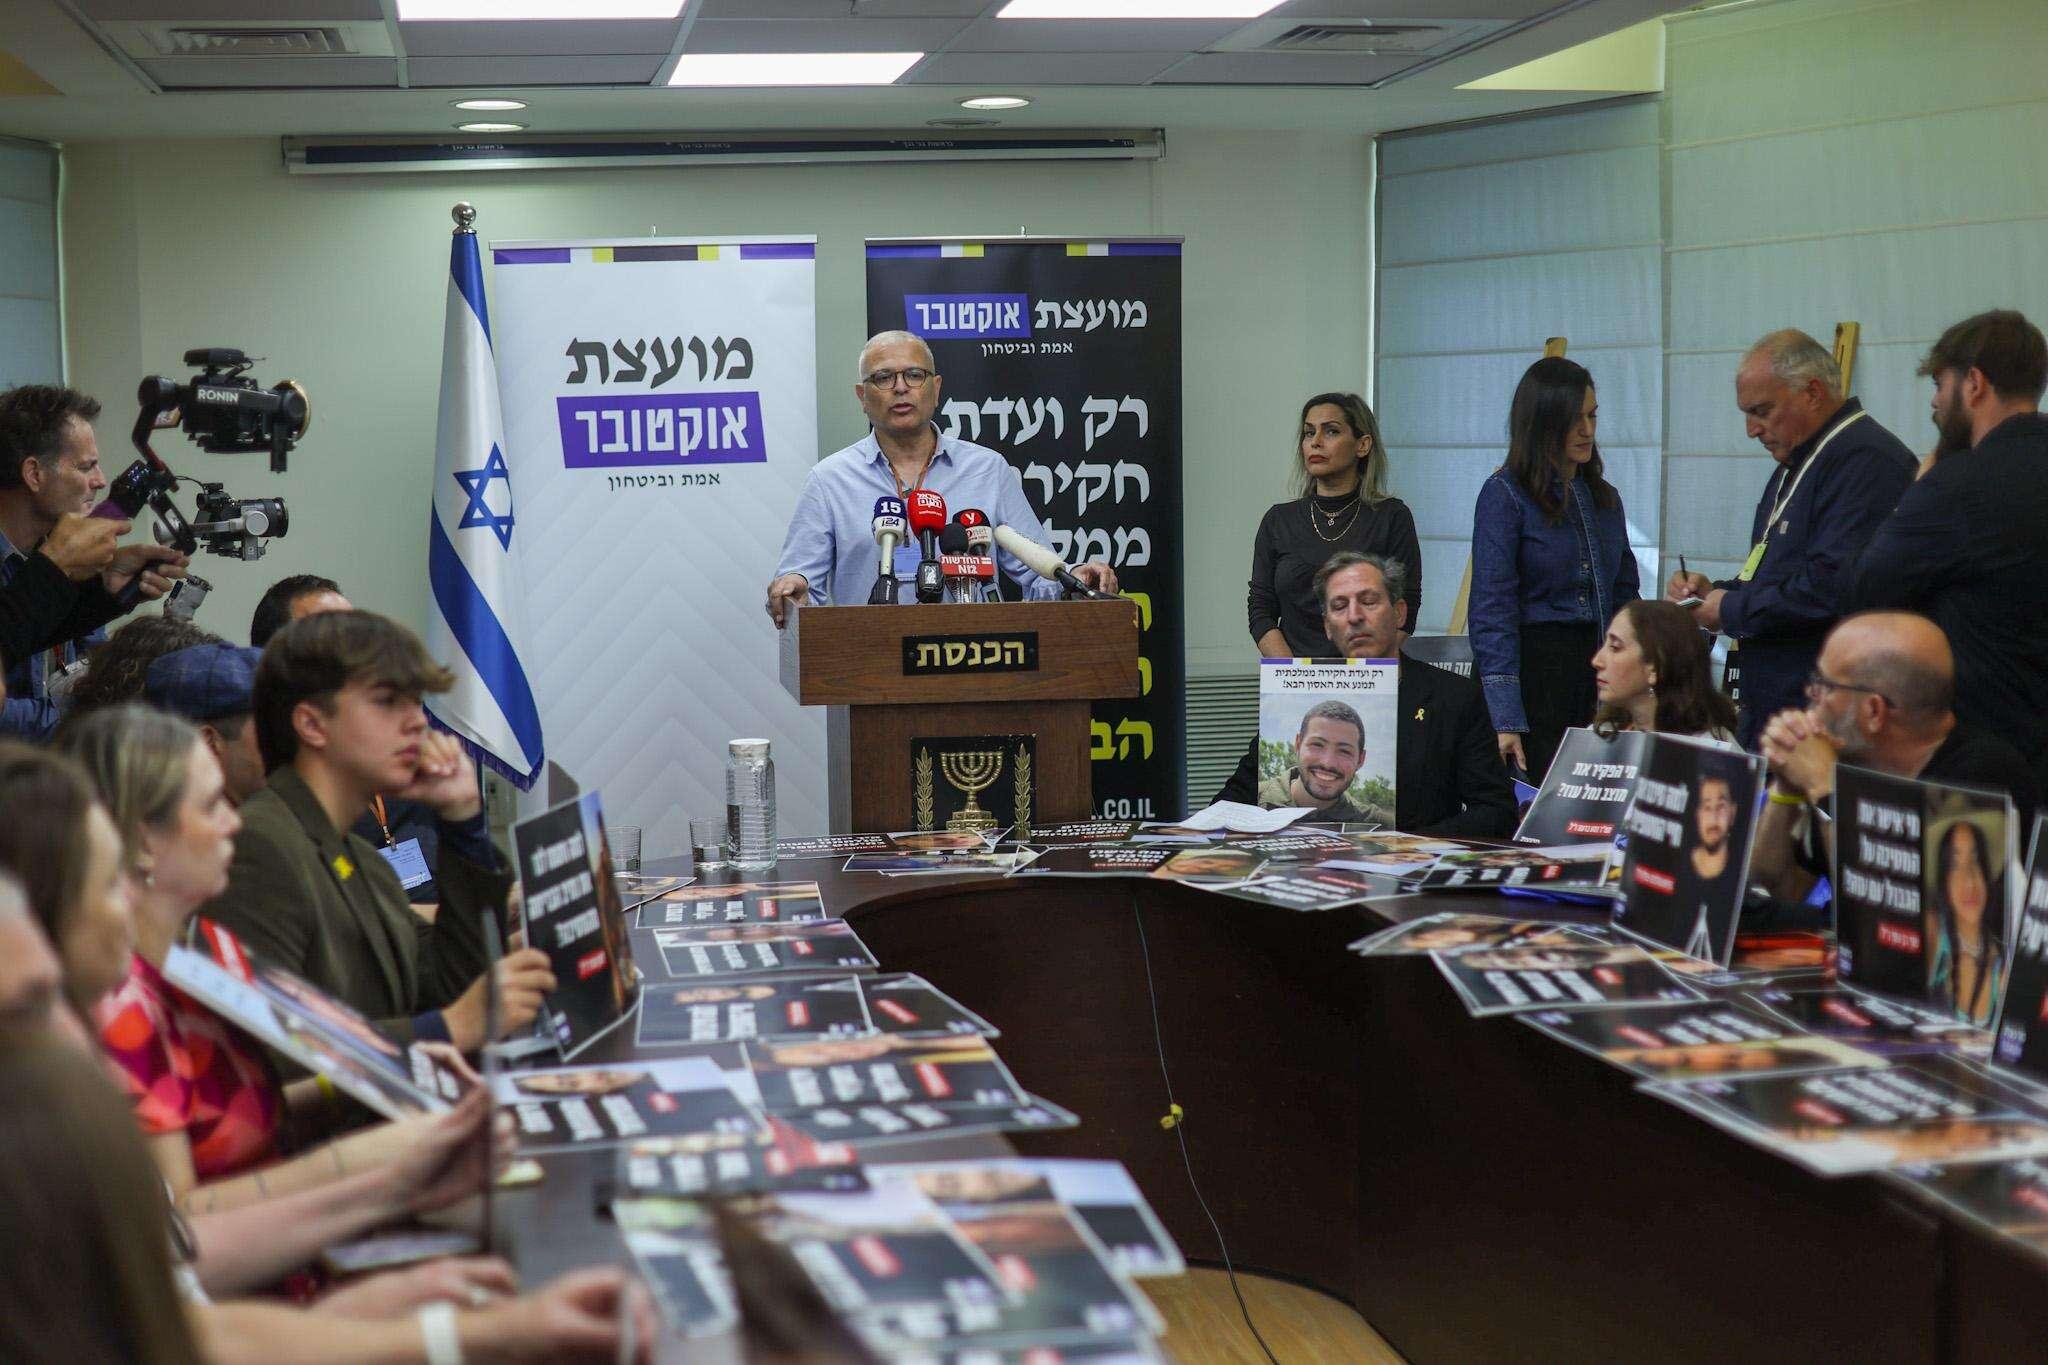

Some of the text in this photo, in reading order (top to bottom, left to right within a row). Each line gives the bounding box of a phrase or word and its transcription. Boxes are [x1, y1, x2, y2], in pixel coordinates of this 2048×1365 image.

[915, 299, 1148, 333] מועצת אוקטובר
[981, 342, 1073, 358] אמת וביטחון
[565, 336, 753, 389] מועצת
[197, 389, 239, 403] RONIN
[574, 405, 749, 456] אוקטובר
[941, 395, 1149, 451] רק ועדת
[608, 472, 721, 491] אמת וביטחון
[880, 501, 902, 514] 15
[1047, 518, 1151, 567] ממל
[941, 556, 980, 565] החדשות
[916, 640, 1025, 667] הכנסת
[1275, 668, 1384, 679] רק ועדת חקירה ממלכתית
[1283, 680, 1375, 690] תמנע את האסון הבא!
[1091, 717, 1153, 760] הב
[1091, 799, 1155, 820] .CO.IL
